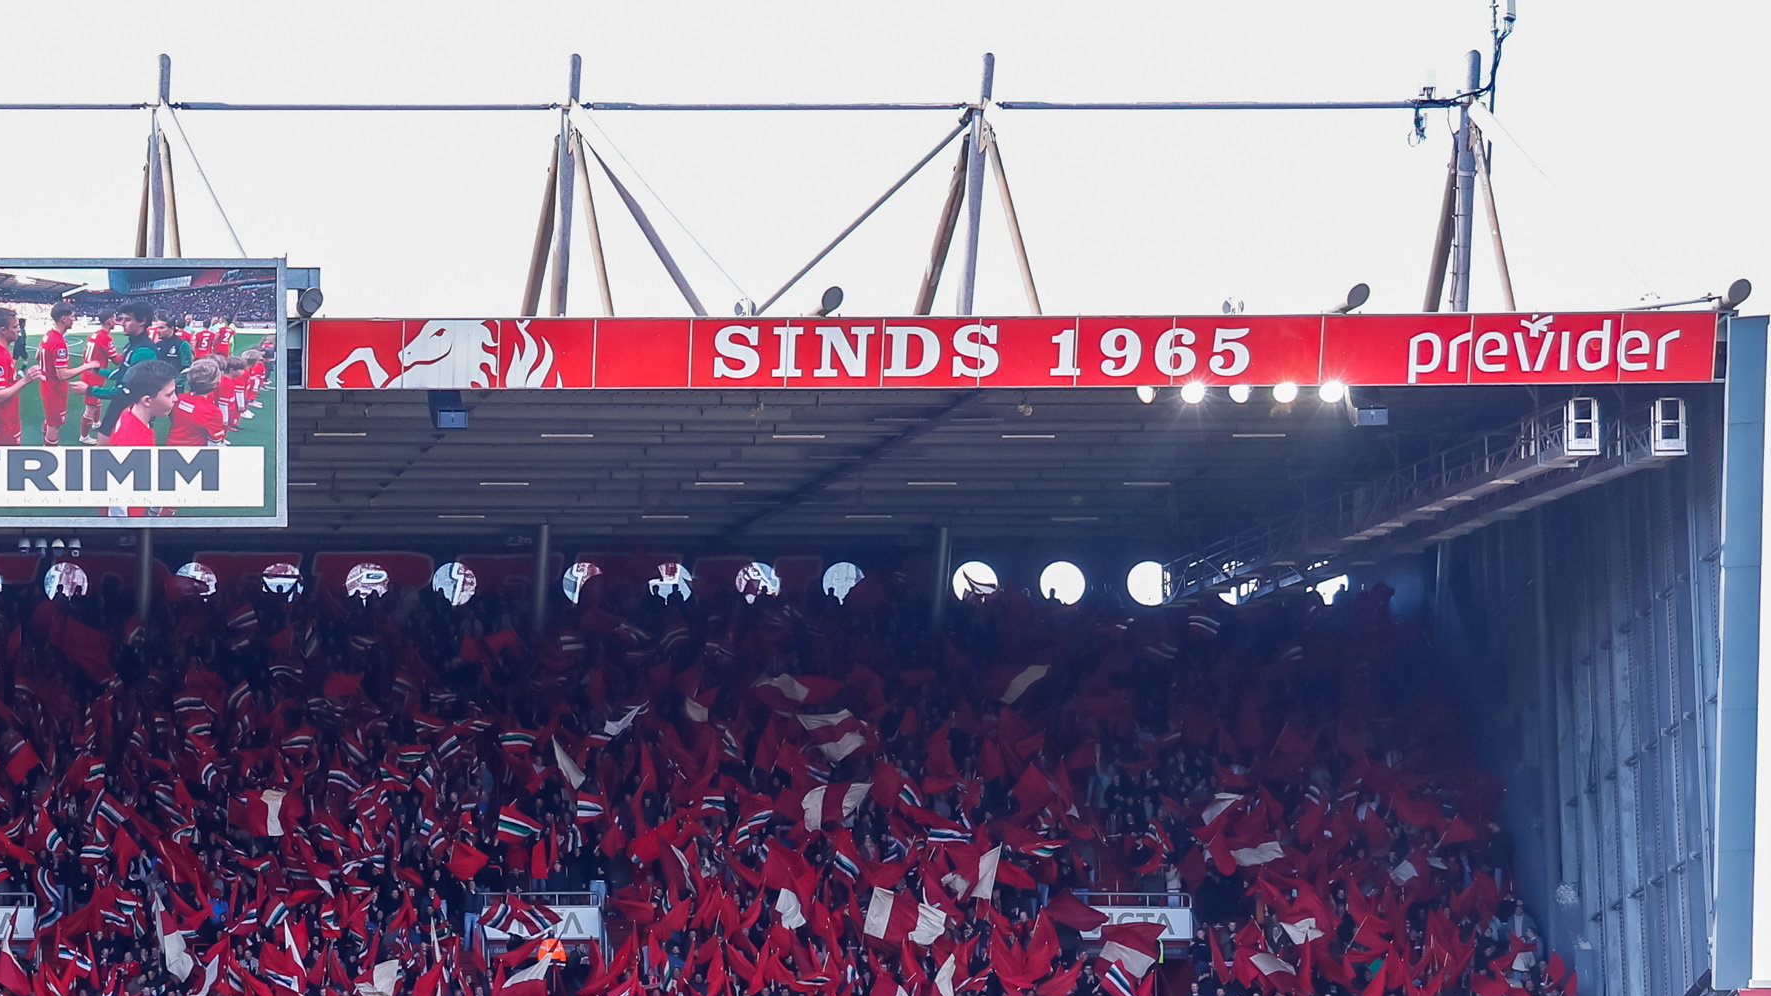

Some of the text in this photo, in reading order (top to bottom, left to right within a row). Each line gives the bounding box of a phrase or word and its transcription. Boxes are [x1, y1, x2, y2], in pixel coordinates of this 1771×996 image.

[713, 325, 1251, 380] SINDS 1965
[1408, 316, 1681, 383] previder
[1099, 912, 1175, 936] ICTA
